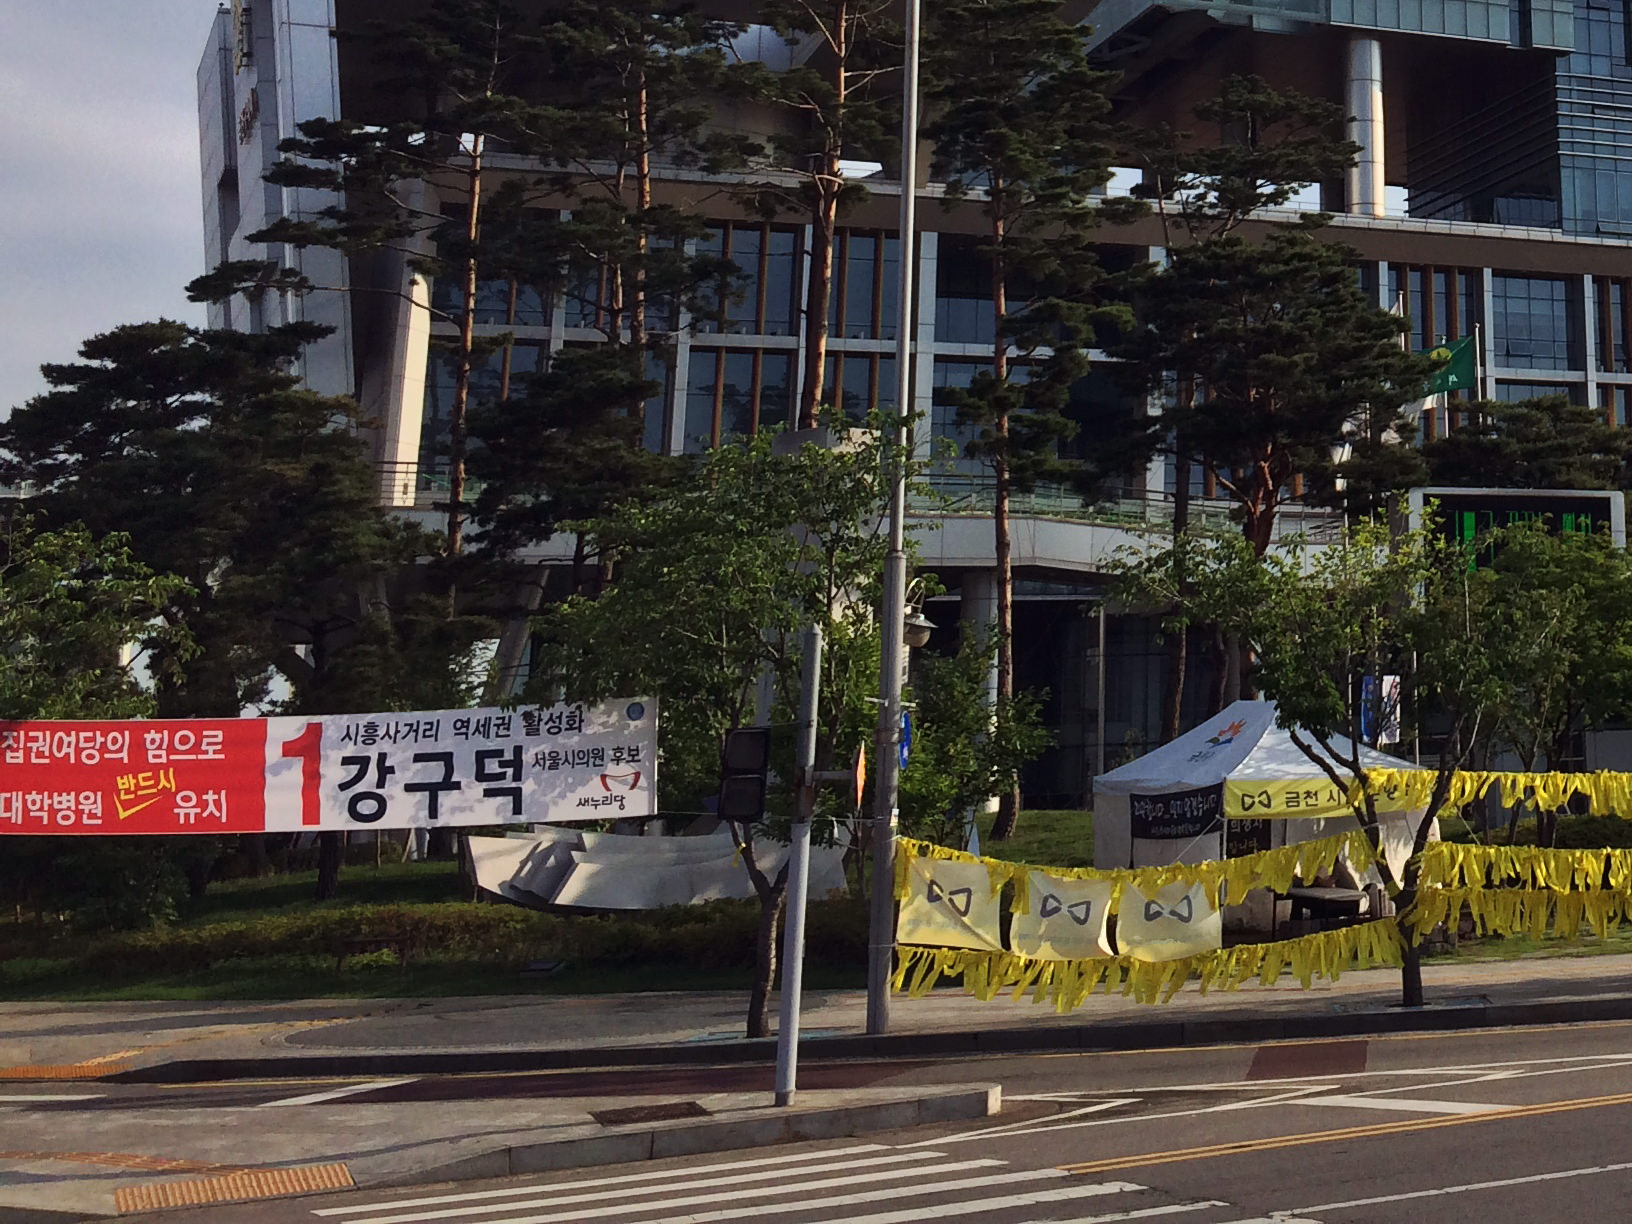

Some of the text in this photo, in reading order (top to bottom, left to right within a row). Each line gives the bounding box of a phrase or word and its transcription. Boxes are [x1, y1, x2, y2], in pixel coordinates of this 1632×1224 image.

[340, 706, 585, 746] 시흥사거리 역세권 활성화
[1, 729, 226, 765] 집권여당의 힘으로
[531, 745, 642, 771] 서울시의원 후보
[116, 767, 176, 801] 반드시
[281, 721, 323, 826] 1
[337, 744, 524, 823] 강구덕
[0, 789, 228, 826] 대학병원 유치
[576, 793, 626, 811] 새누리당
[1285, 789, 1319, 809] 금천
